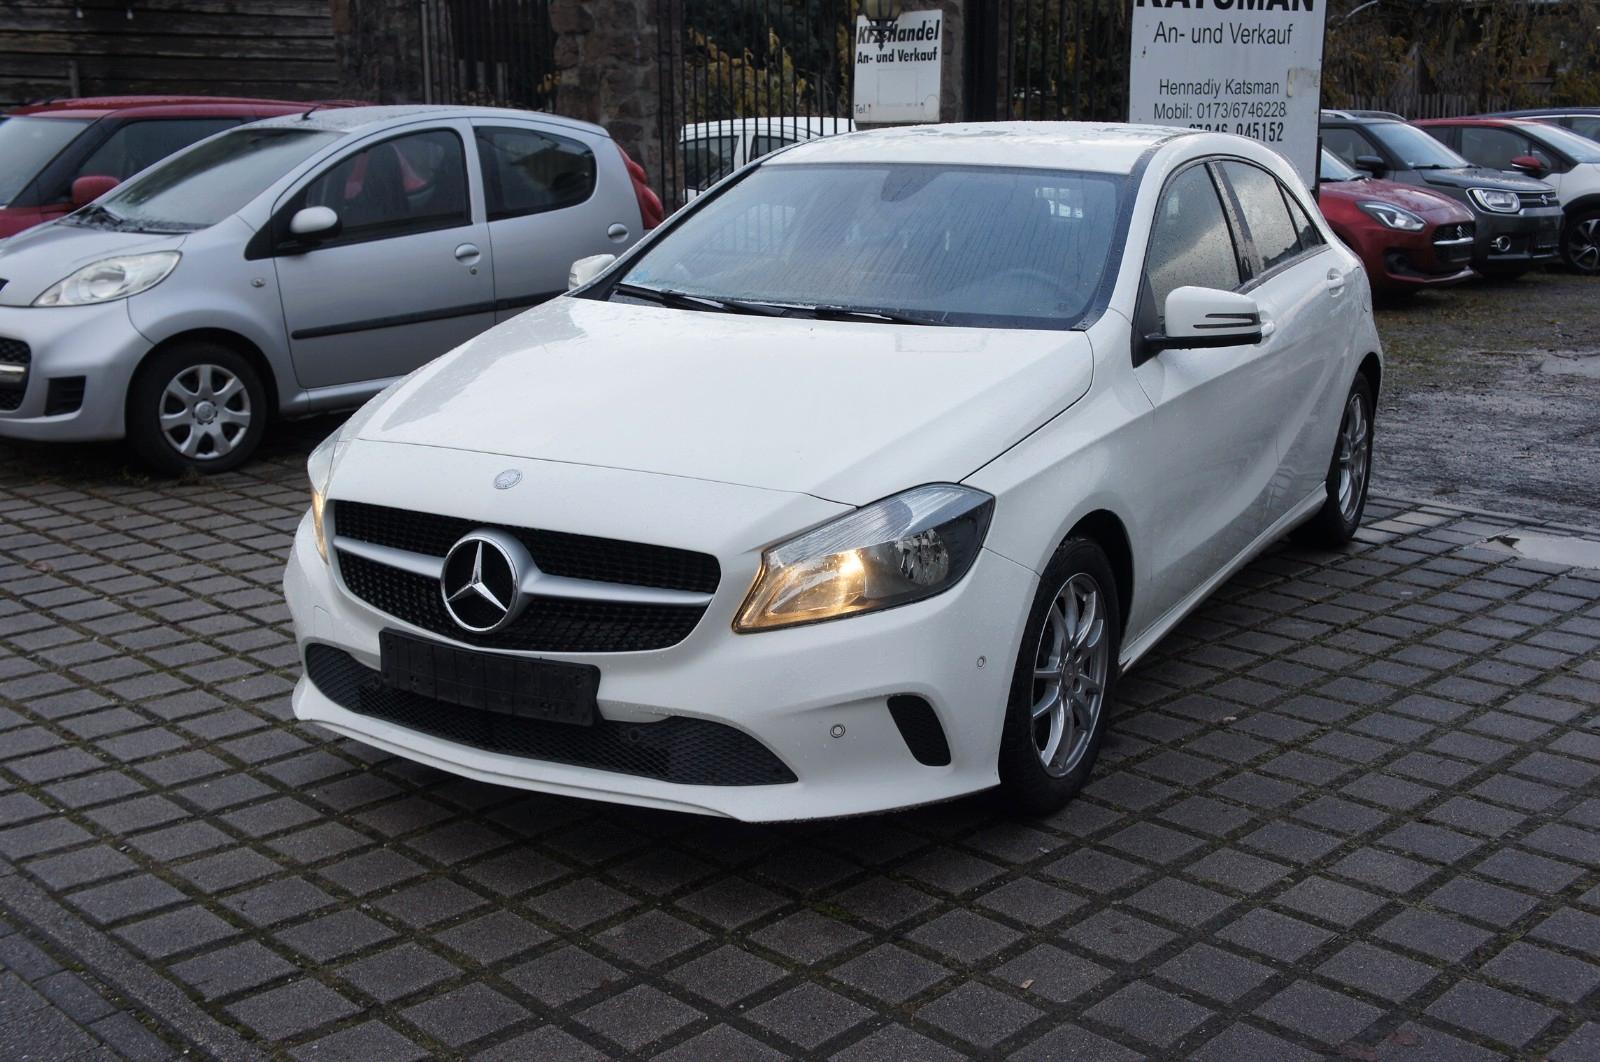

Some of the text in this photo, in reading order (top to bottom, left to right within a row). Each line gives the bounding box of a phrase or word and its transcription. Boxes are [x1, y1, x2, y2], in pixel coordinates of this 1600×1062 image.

[1153, 21, 1294, 45] An- und Verkauf
[857, 46, 938, 64] An- und Verkauf
[1159, 78, 1280, 99] Hennadiy Katsman
[1153, 101, 1286, 119] Mobil: 0173/6746228
